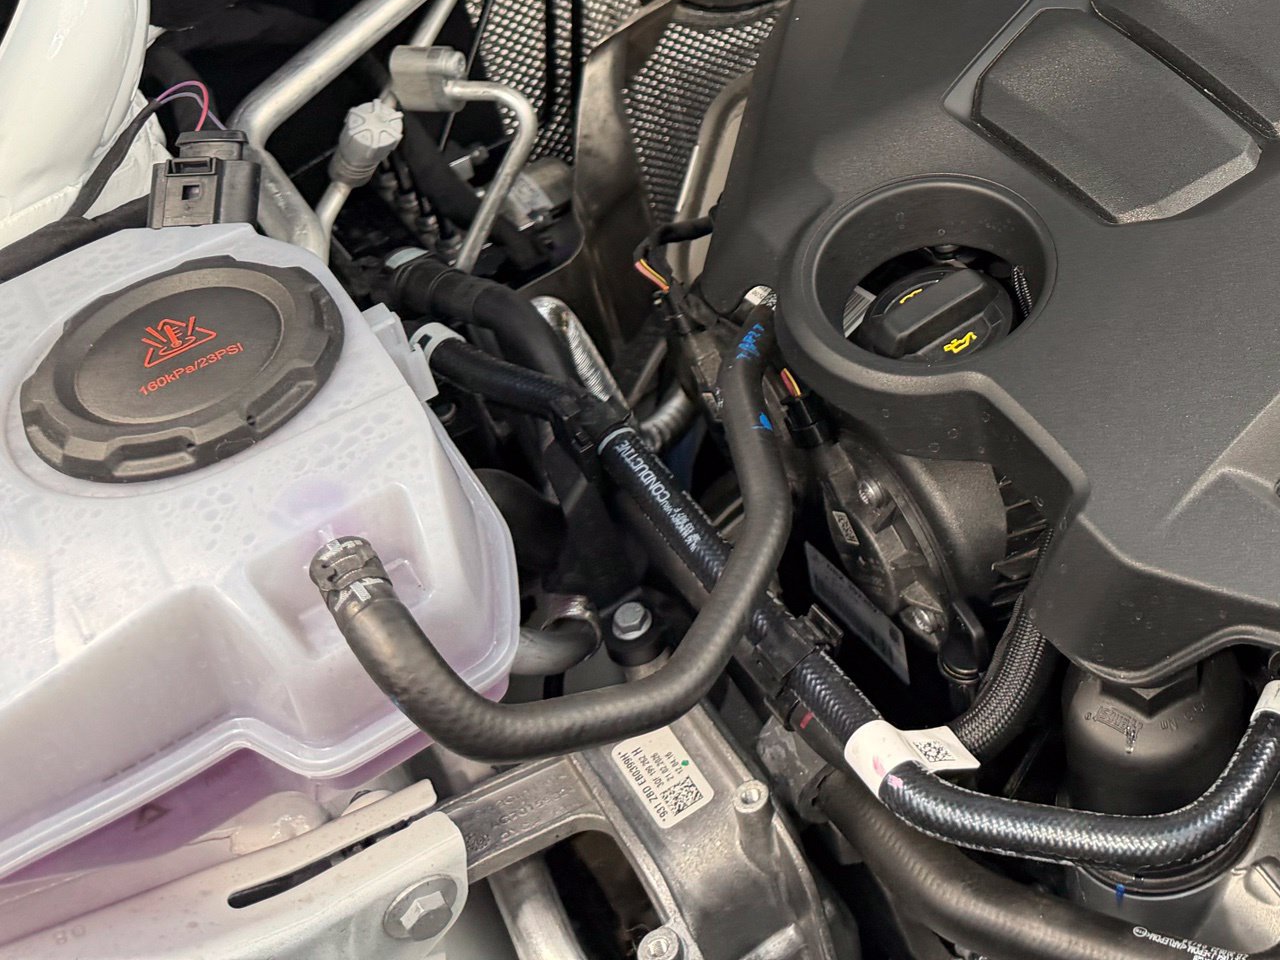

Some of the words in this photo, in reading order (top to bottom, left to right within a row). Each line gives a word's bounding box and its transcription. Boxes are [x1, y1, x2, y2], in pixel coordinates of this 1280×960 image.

[139, 343, 243, 395] 160kPa/23PSI
[615, 440, 671, 503] CONDUCTIVE
[631, 746, 643, 758] H
